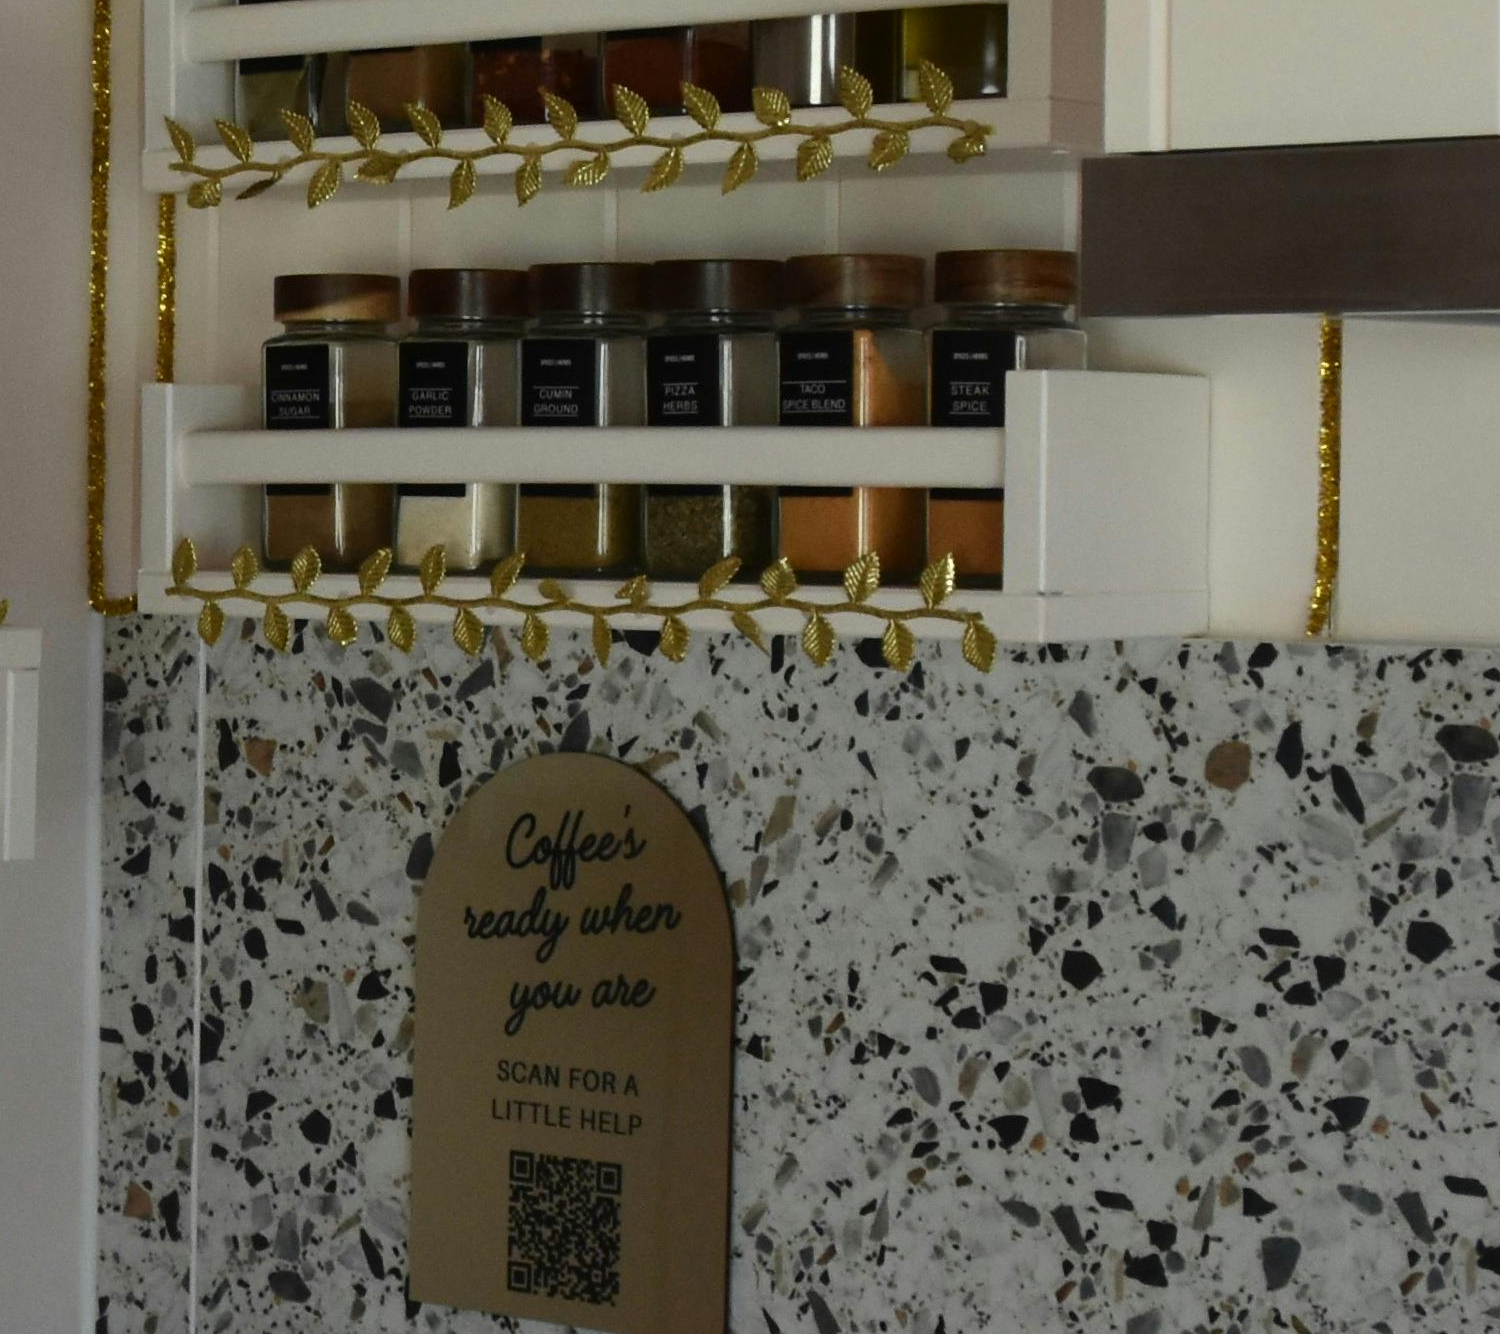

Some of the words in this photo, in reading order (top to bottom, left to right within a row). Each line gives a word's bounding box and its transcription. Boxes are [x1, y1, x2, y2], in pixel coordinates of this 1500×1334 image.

[539, 389, 573, 400] CUMIN
[664, 385, 696, 396] PIZZA
[800, 384, 826, 395] TACO
[950, 384, 990, 396] STEAK
[271, 392, 321, 402] CINNAMON
[411, 391, 449, 402] GARLIC
[533, 403, 579, 414] GROUND
[663, 400, 698, 411] HERBS
[782, 399, 810, 410] SPICE
[811, 398, 846, 410] BLEND
[952, 400, 988, 412] SPICE
[279, 407, 311, 416] SUGAR
[408, 405, 453, 415] POWDER
[505, 803, 647, 891] Coffee's
[463, 885, 570, 964] ready
[579, 882, 683, 936] when
[503, 979, 582, 1037] you
[591, 973, 657, 1009] are
[496, 1058, 561, 1089] SCAN
[568, 1067, 617, 1095] FOR
[622, 1072, 640, 1098] A
[491, 1098, 572, 1129] LITTLE
[580, 1107, 643, 1137] HELP
